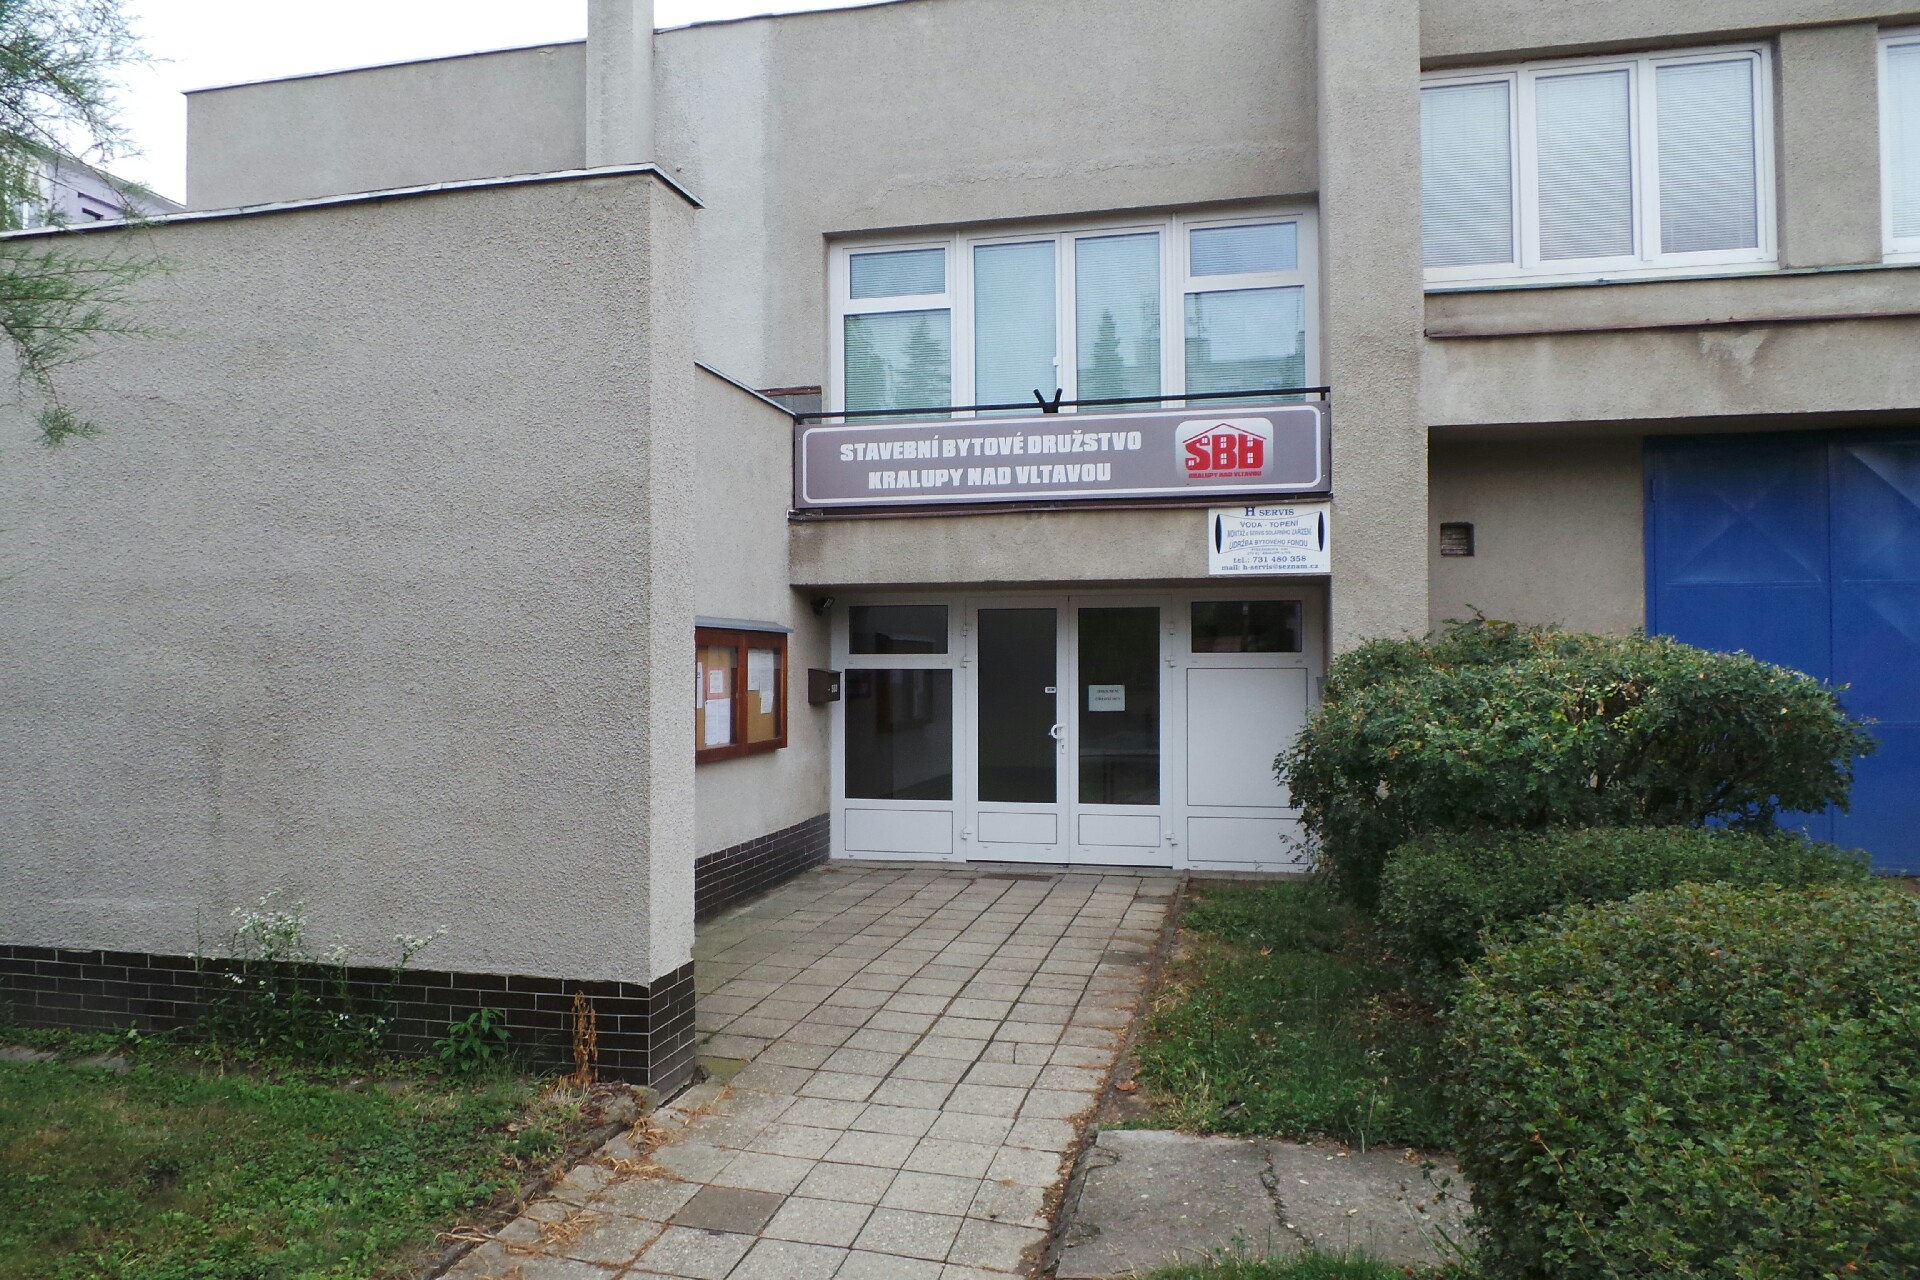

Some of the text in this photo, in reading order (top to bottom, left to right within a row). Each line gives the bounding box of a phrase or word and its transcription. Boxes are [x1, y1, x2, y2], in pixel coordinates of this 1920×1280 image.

[841, 430, 1141, 461] STAVEBNÍ BYTOVÉ DRUŽSTVO
[868, 463, 1111, 489] KRALUPY NAD VLTAVOU
[1245, 506, 1295, 516] H SERVIS
[1270, 520, 1299, 528] TOPENÍ
